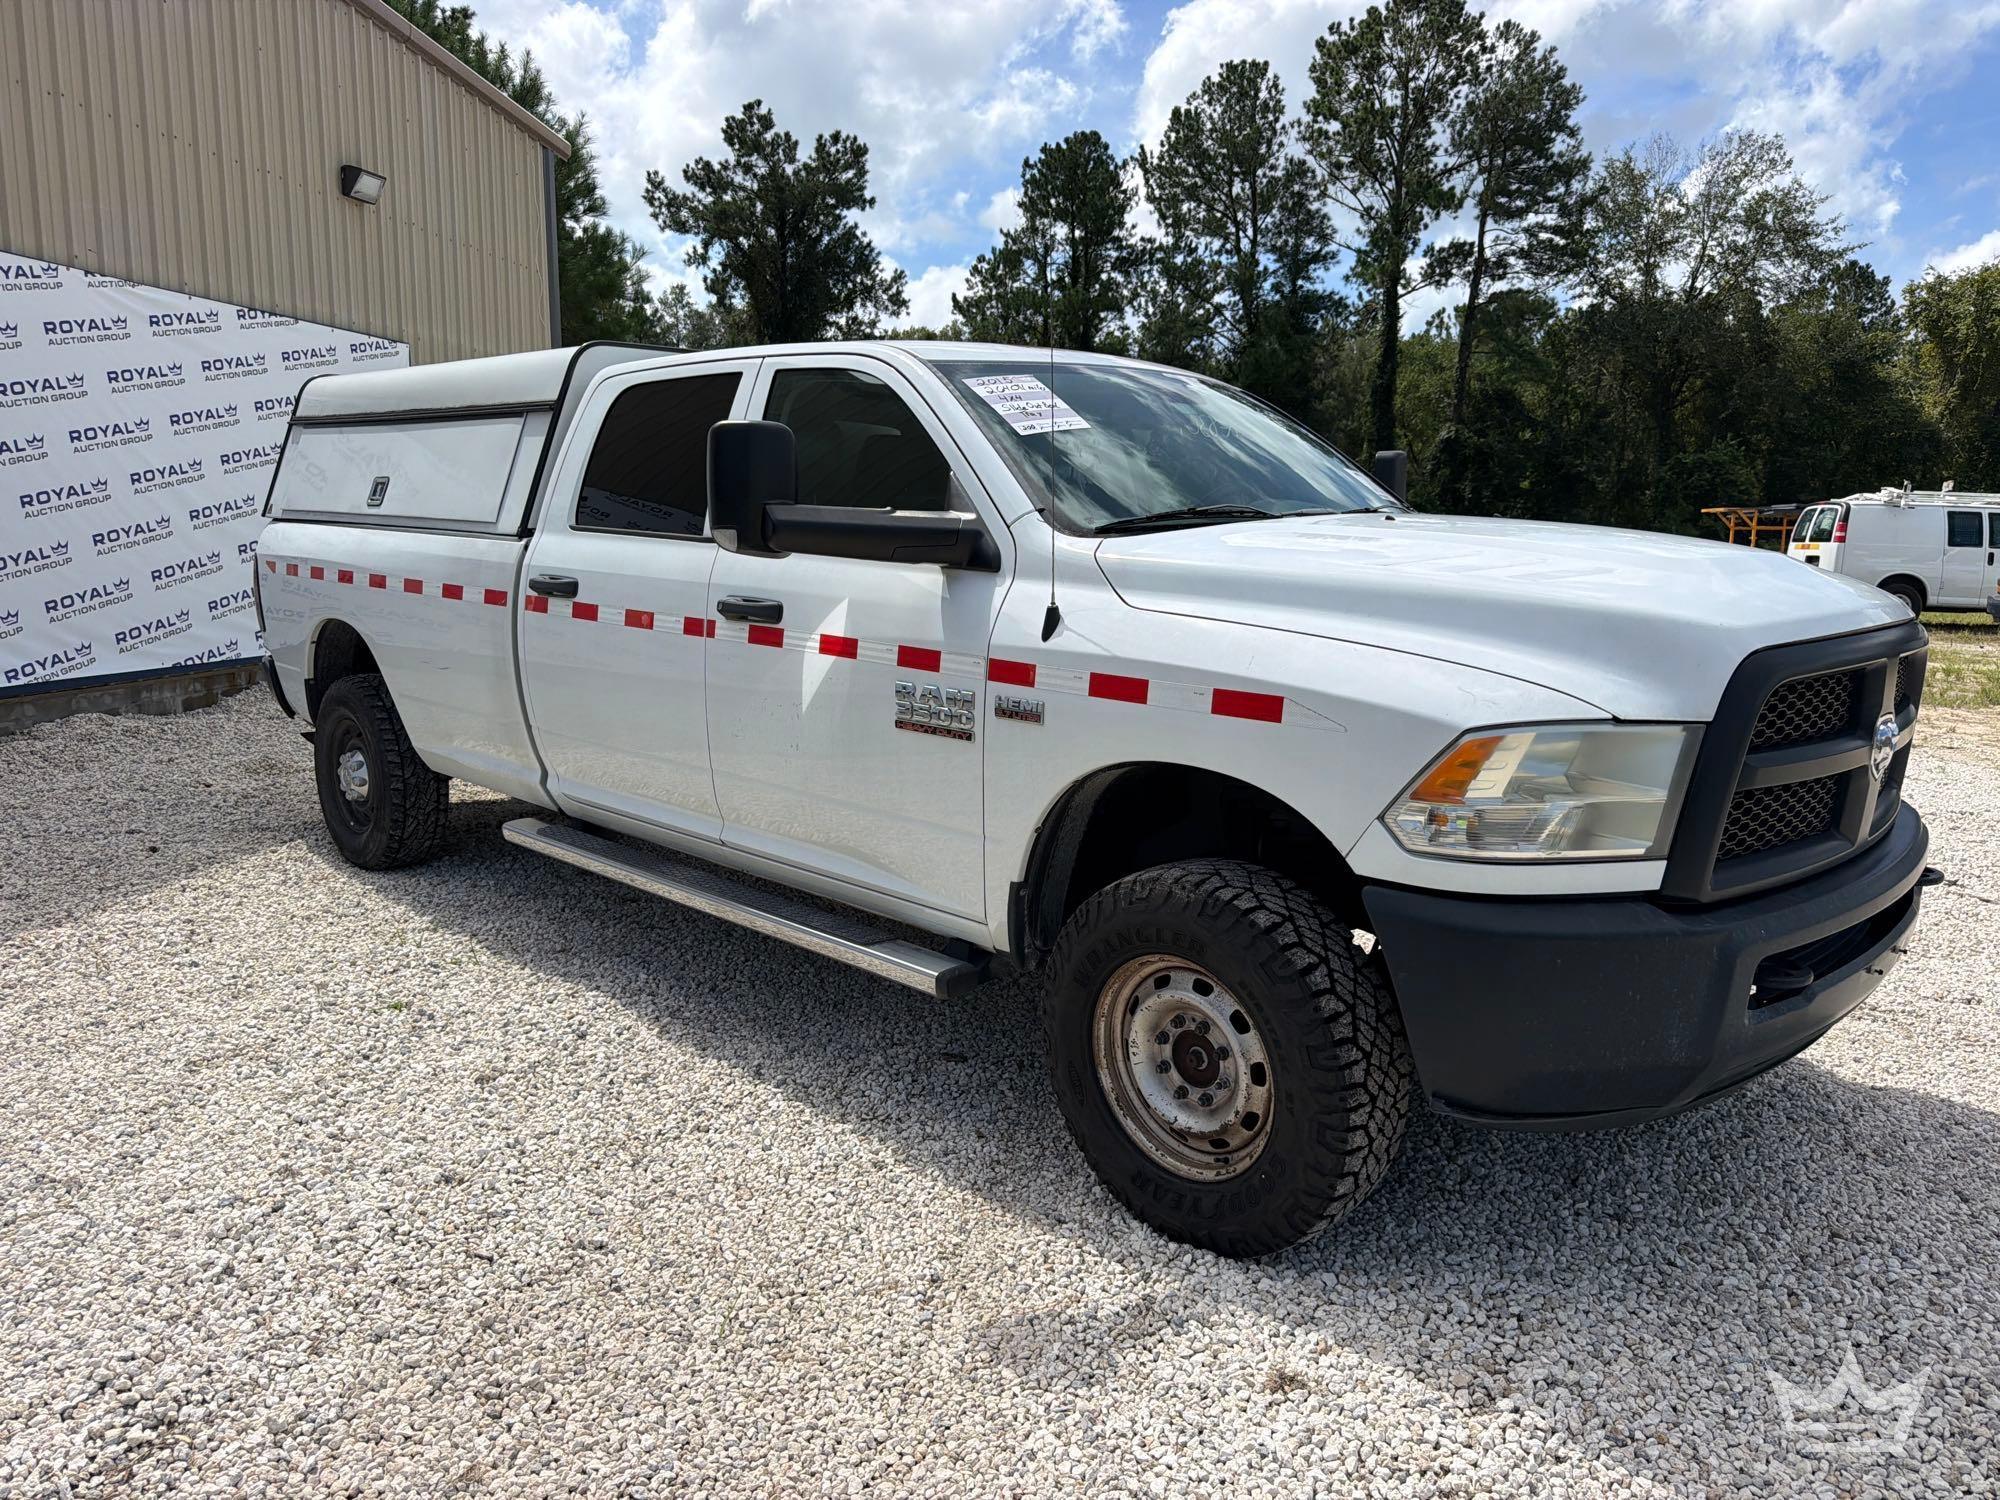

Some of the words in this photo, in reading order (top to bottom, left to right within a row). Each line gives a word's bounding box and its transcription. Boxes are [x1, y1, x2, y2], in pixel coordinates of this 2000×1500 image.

[0, 264, 41, 279] YAL
[25, 282, 63, 290] GROUP
[87, 280, 130, 288] AUCTION
[44, 318, 113, 335] ROYAL
[149, 312, 206, 327] ROYAL
[240, 321, 273, 330] AUCTION
[274, 318, 299, 327] GROUP
[48, 335, 95, 346] AUCTION
[97, 332, 131, 342] GROUP
[152, 328, 192, 337] AUCTION
[193, 325, 222, 334] GROUP
[0, 341, 22, 350] OUP
[350, 341, 388, 354] ROYAL
[202, 355, 253, 372] ROYAL
[282, 348, 325, 363] ROYAL
[353, 354, 379, 362] AUCTION
[107, 365, 168, 383] ROYAL
[285, 363, 315, 371] AUCTION
[317, 359, 338, 367] GROUP
[205, 372, 240, 382] AUCTION
[242, 368, 268, 377] GROUP
[976, 376, 1013, 387] 2015
[111, 383, 153, 394] AUCTION
[155, 378, 185, 388] GROUP
[51, 391, 88, 402] GROUP
[169, 407, 222, 427] ROYAL
[258, 411, 290, 421] AUCTION
[69, 422, 135, 443] ROYAL
[173, 424, 211, 436] AUCTION
[212, 418, 240, 430] GROUP
[73, 441, 119, 454] AUCTION
[120, 434, 153, 445] GROUP
[8, 452, 48, 466] GROUP
[220, 446, 271, 466] ROYAL
[130, 463, 188, 485] ROYAL
[224, 462, 257, 475] AUCTION
[134, 480, 174, 495] AUCTION
[176, 473, 205, 486] GROUP
[20, 483, 91, 508] ROYAL
[24, 503, 73, 519] AUCTION
[75, 494, 112, 507] GROUP
[189, 499, 243, 522] ROYAL
[193, 517, 229, 531] AUCTION
[231, 508, 258, 521] GROUP
[92, 520, 156, 547] ROYAL
[96, 540, 140, 557] AUCTION
[142, 531, 173, 544] GROUP
[34, 557, 72, 573] GROUP
[152, 557, 207, 582] ROYAL
[155, 573, 195, 592] AUCTION
[196, 565, 224, 578] GROUP
[45, 584, 114, 614] ROYAL
[49, 605, 96, 624] AUCTION
[98, 593, 134, 609] GROUP
[212, 604, 246, 621] AUCTION
[0, 626, 23, 640] OUP
[115, 615, 176, 645] ROYAL
[119, 634, 161, 654] AUCTION
[162, 623, 193, 639] GROUP
[4, 649, 76, 684] ROYAL
[61, 657, 96, 675] GROUP
[895, 680, 976, 711] RAM
[994, 695, 1045, 713] HEMI
[896, 720, 934, 734] HEAVY
[935, 728, 973, 742] DUTY
